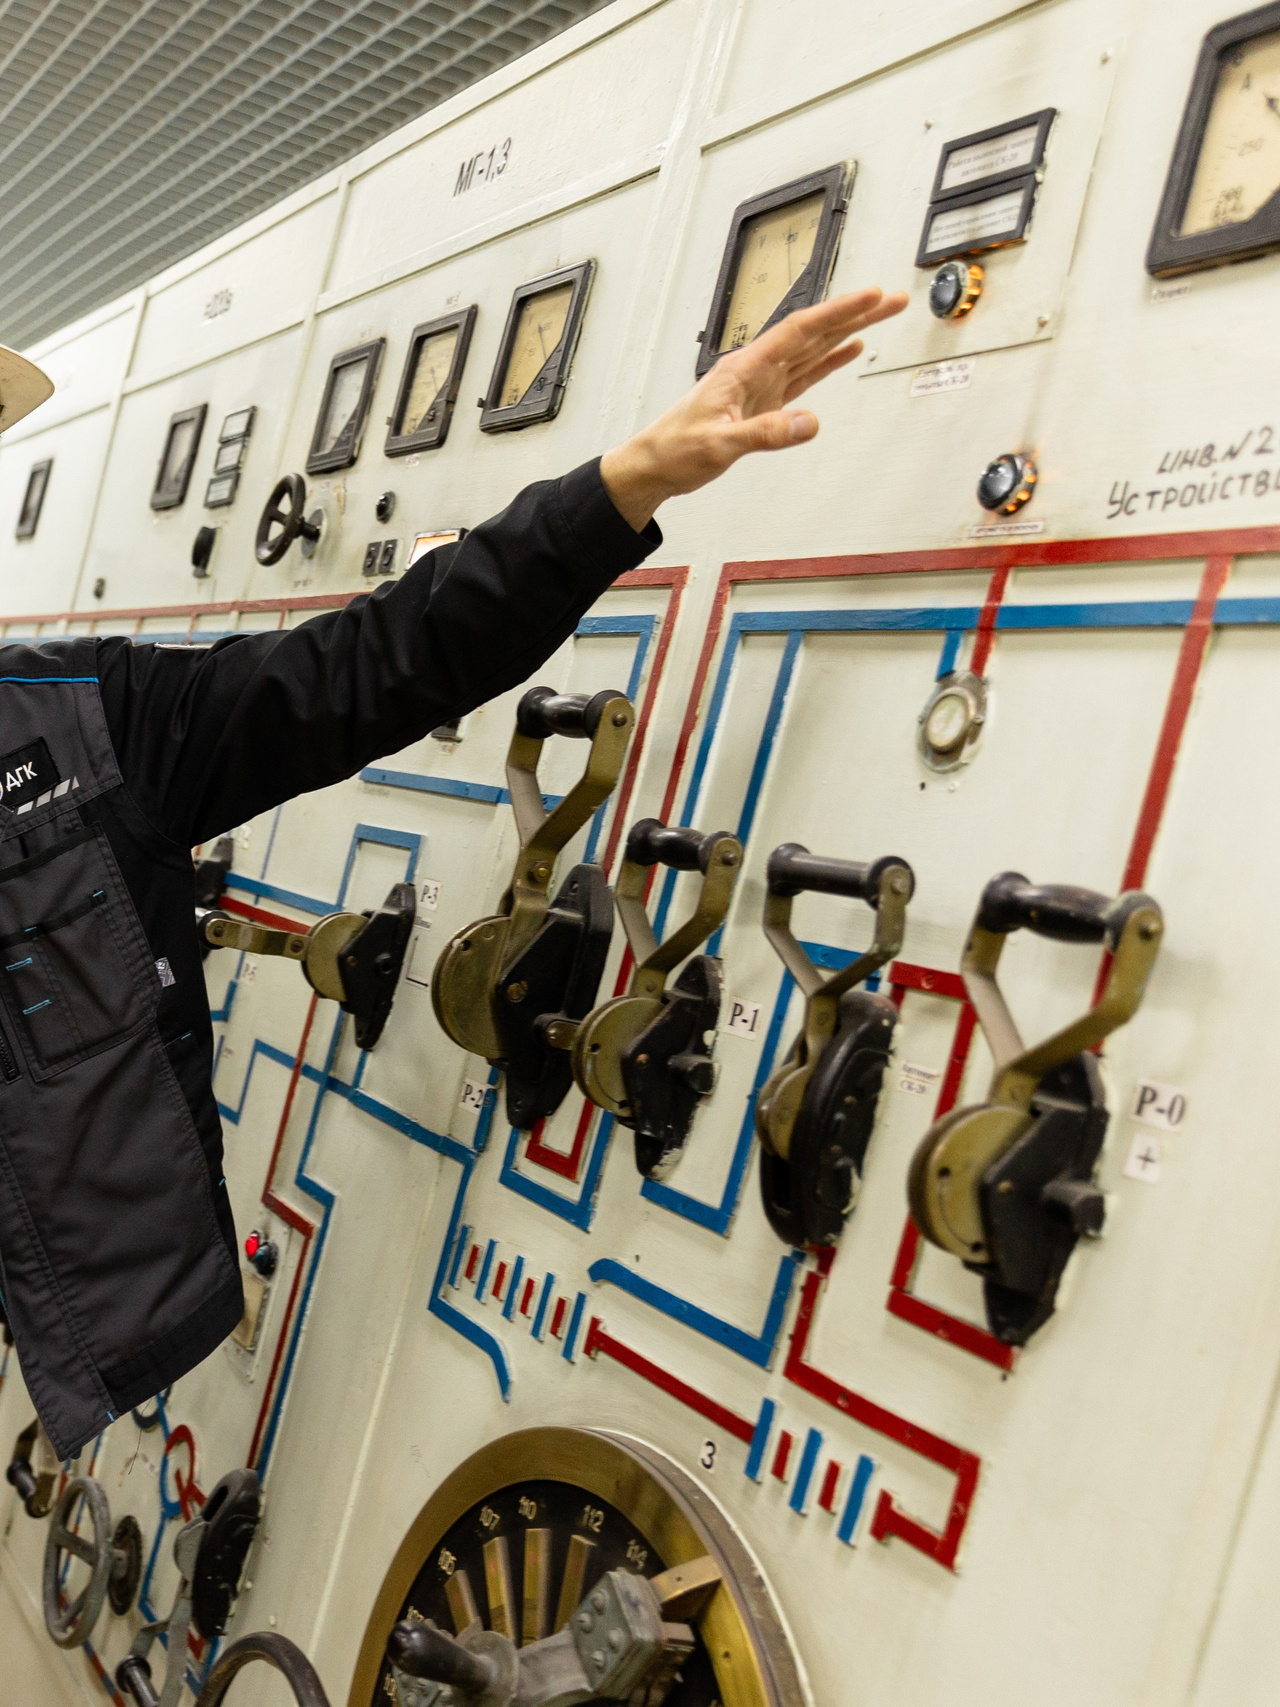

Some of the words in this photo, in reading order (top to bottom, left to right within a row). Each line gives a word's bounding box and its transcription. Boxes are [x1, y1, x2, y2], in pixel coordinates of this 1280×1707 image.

[5, 761, 38, 793] ДГК
[701, 1440, 717, 1470] 3
[479, 1504, 501, 1531] 107
[519, 1495, 538, 1520] 110
[582, 1504, 605, 1533] 112
